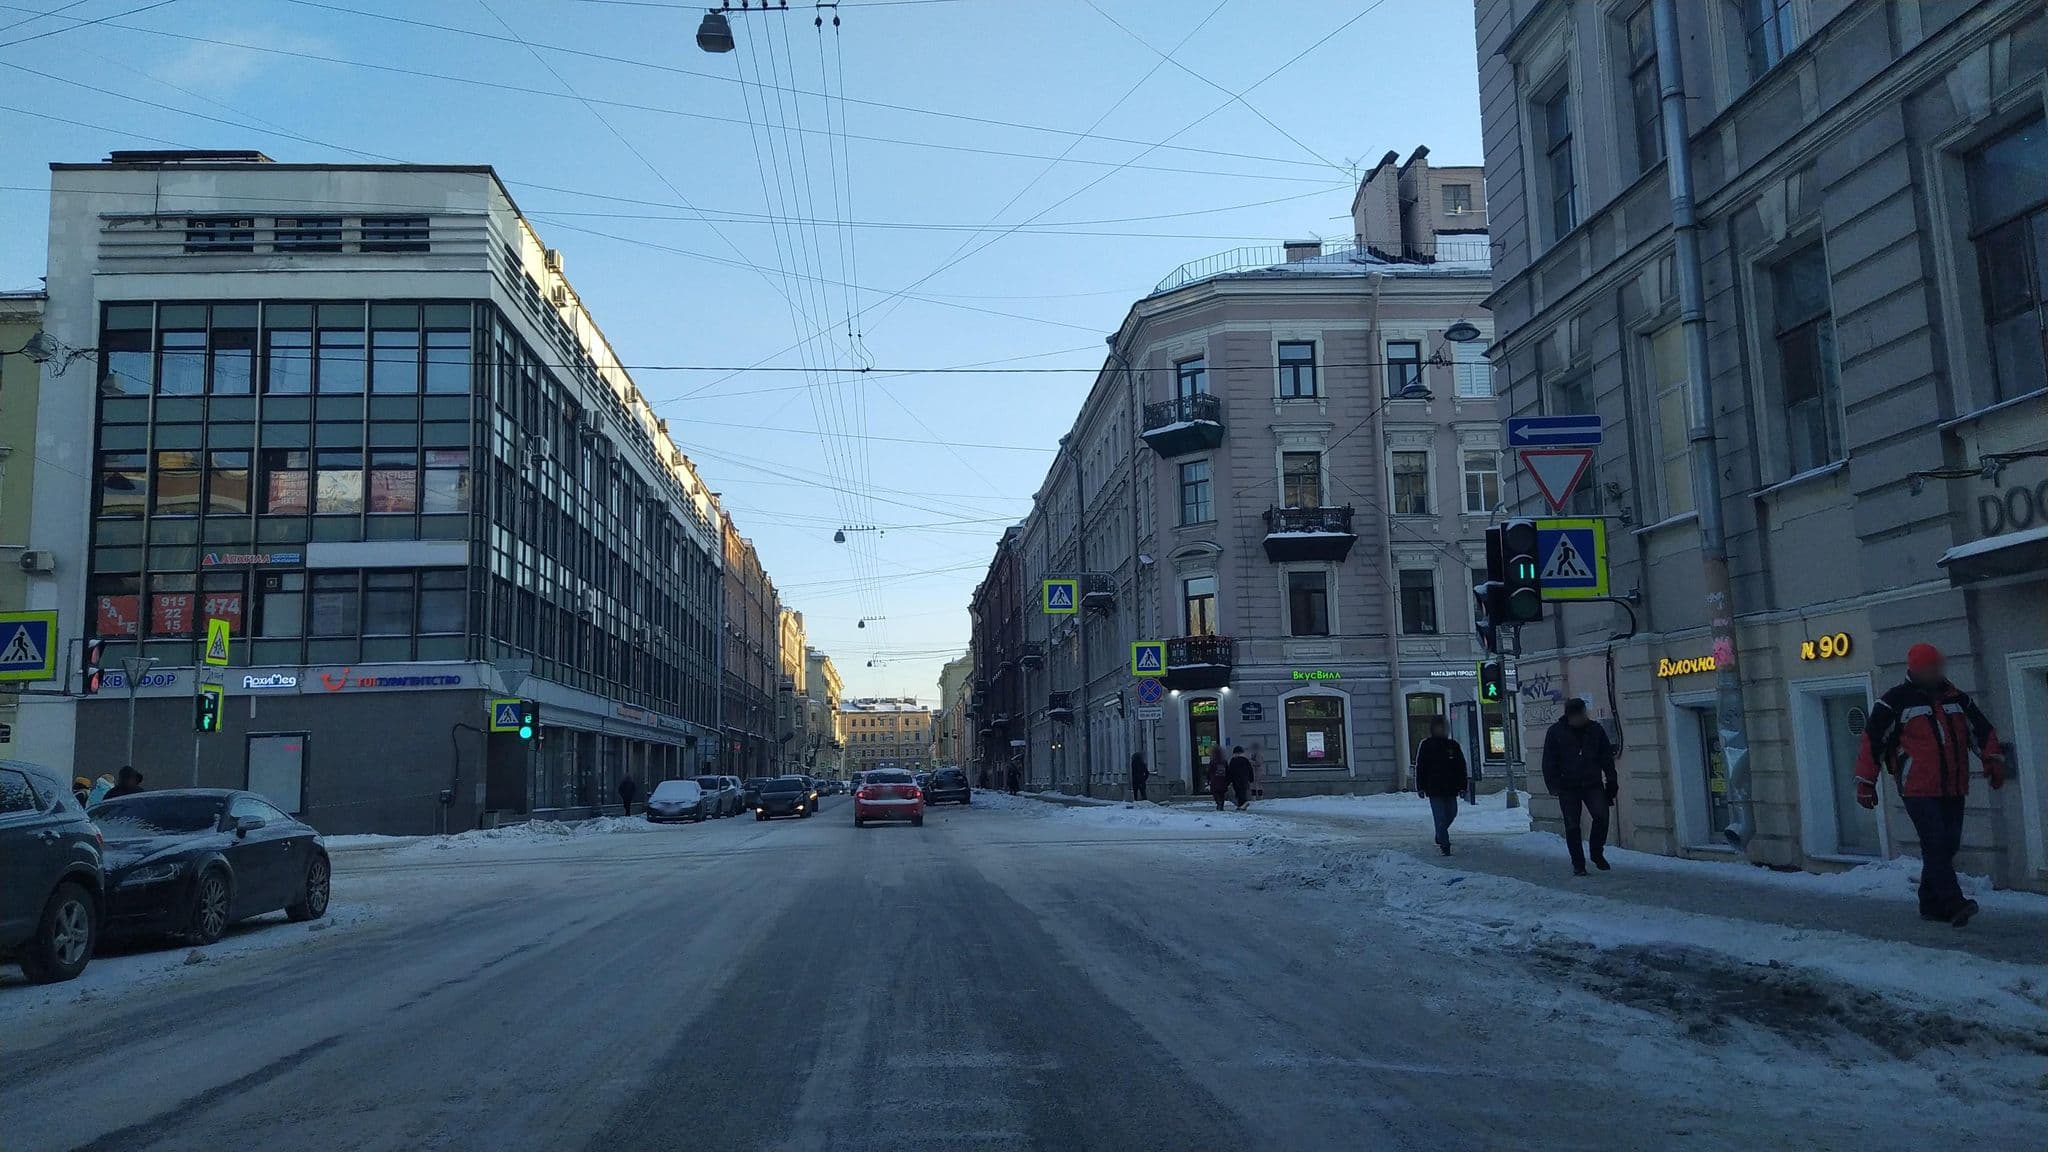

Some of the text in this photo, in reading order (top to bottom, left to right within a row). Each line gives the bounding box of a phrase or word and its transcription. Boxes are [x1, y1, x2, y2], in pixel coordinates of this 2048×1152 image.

[161, 597, 186, 607] 915
[205, 599, 239, 614] 474
[102, 597, 137, 633] SALE
[165, 609, 181, 618] 22
[165, 620, 181, 630] 15
[1819, 632, 1849, 658] 90
[1658, 656, 1716, 677] Булочна
[101, 672, 176, 688] КВФОР
[1293, 670, 1341, 681] ВкусВилл
